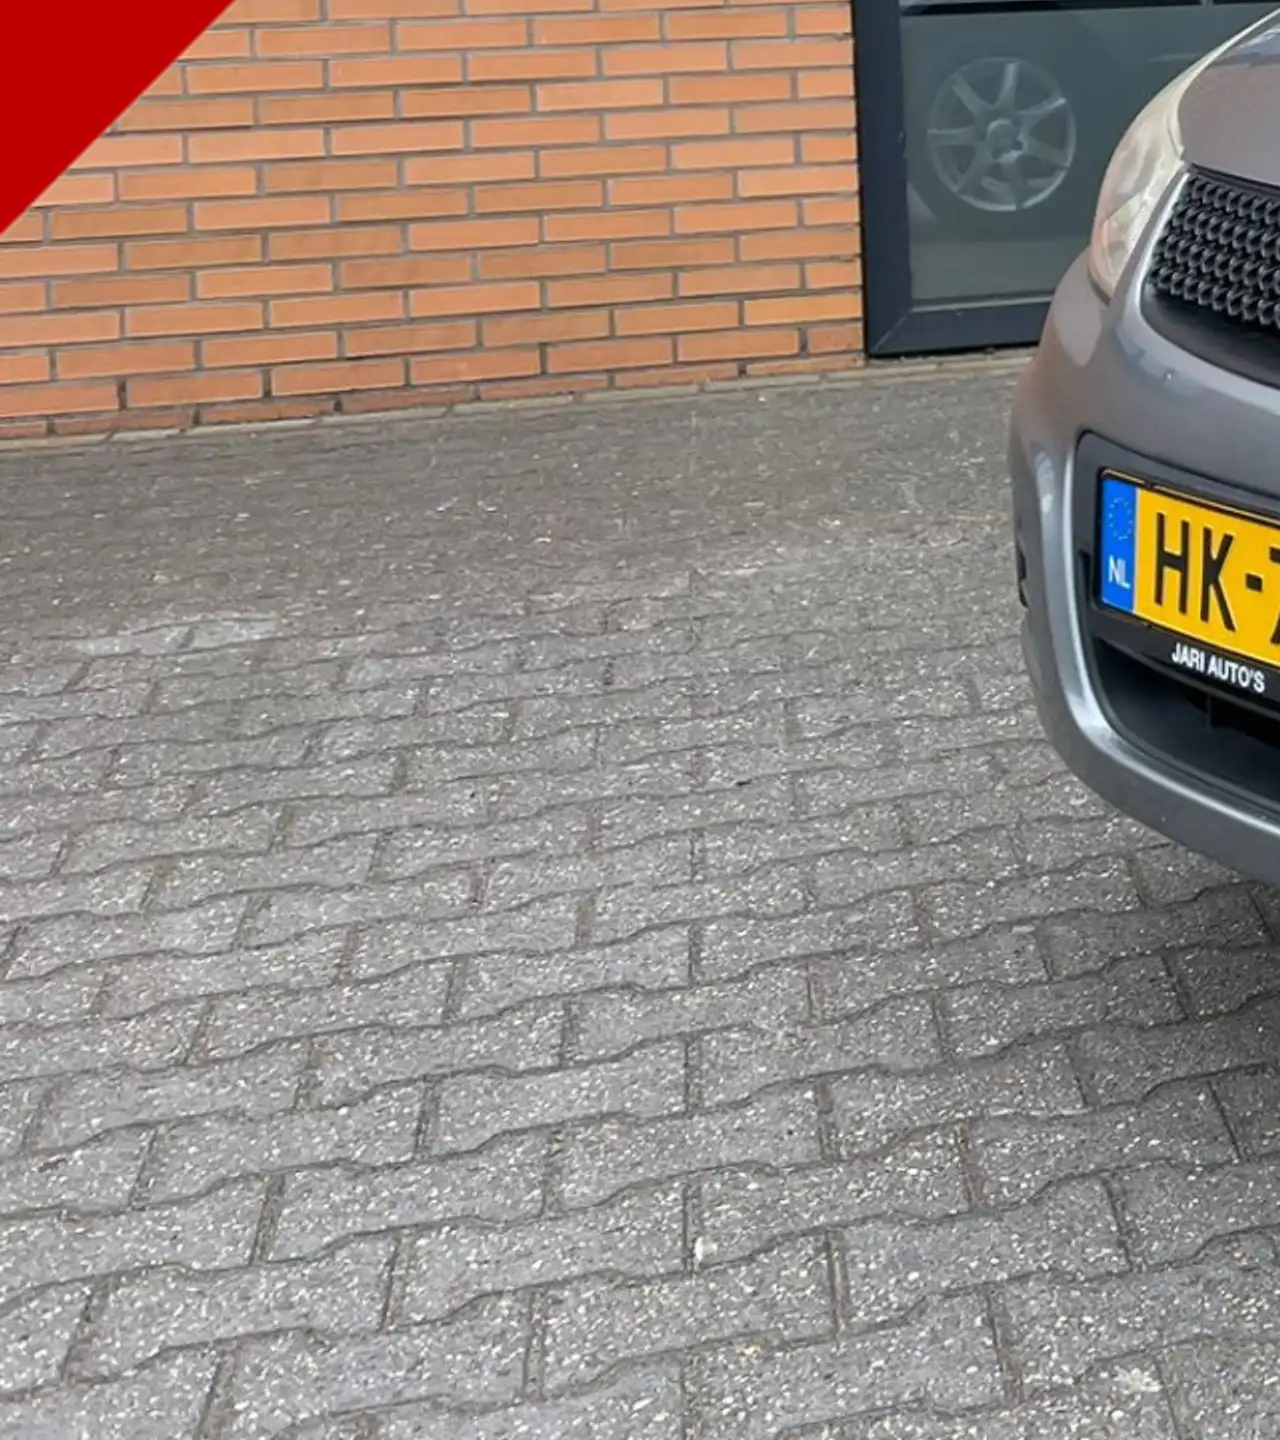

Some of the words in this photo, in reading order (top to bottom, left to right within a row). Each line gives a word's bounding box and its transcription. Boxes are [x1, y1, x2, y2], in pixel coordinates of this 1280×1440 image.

[1108, 554, 1130, 590] NL
[1171, 641, 1207, 672] JARI
[1208, 659, 1266, 694] AUTO'S
